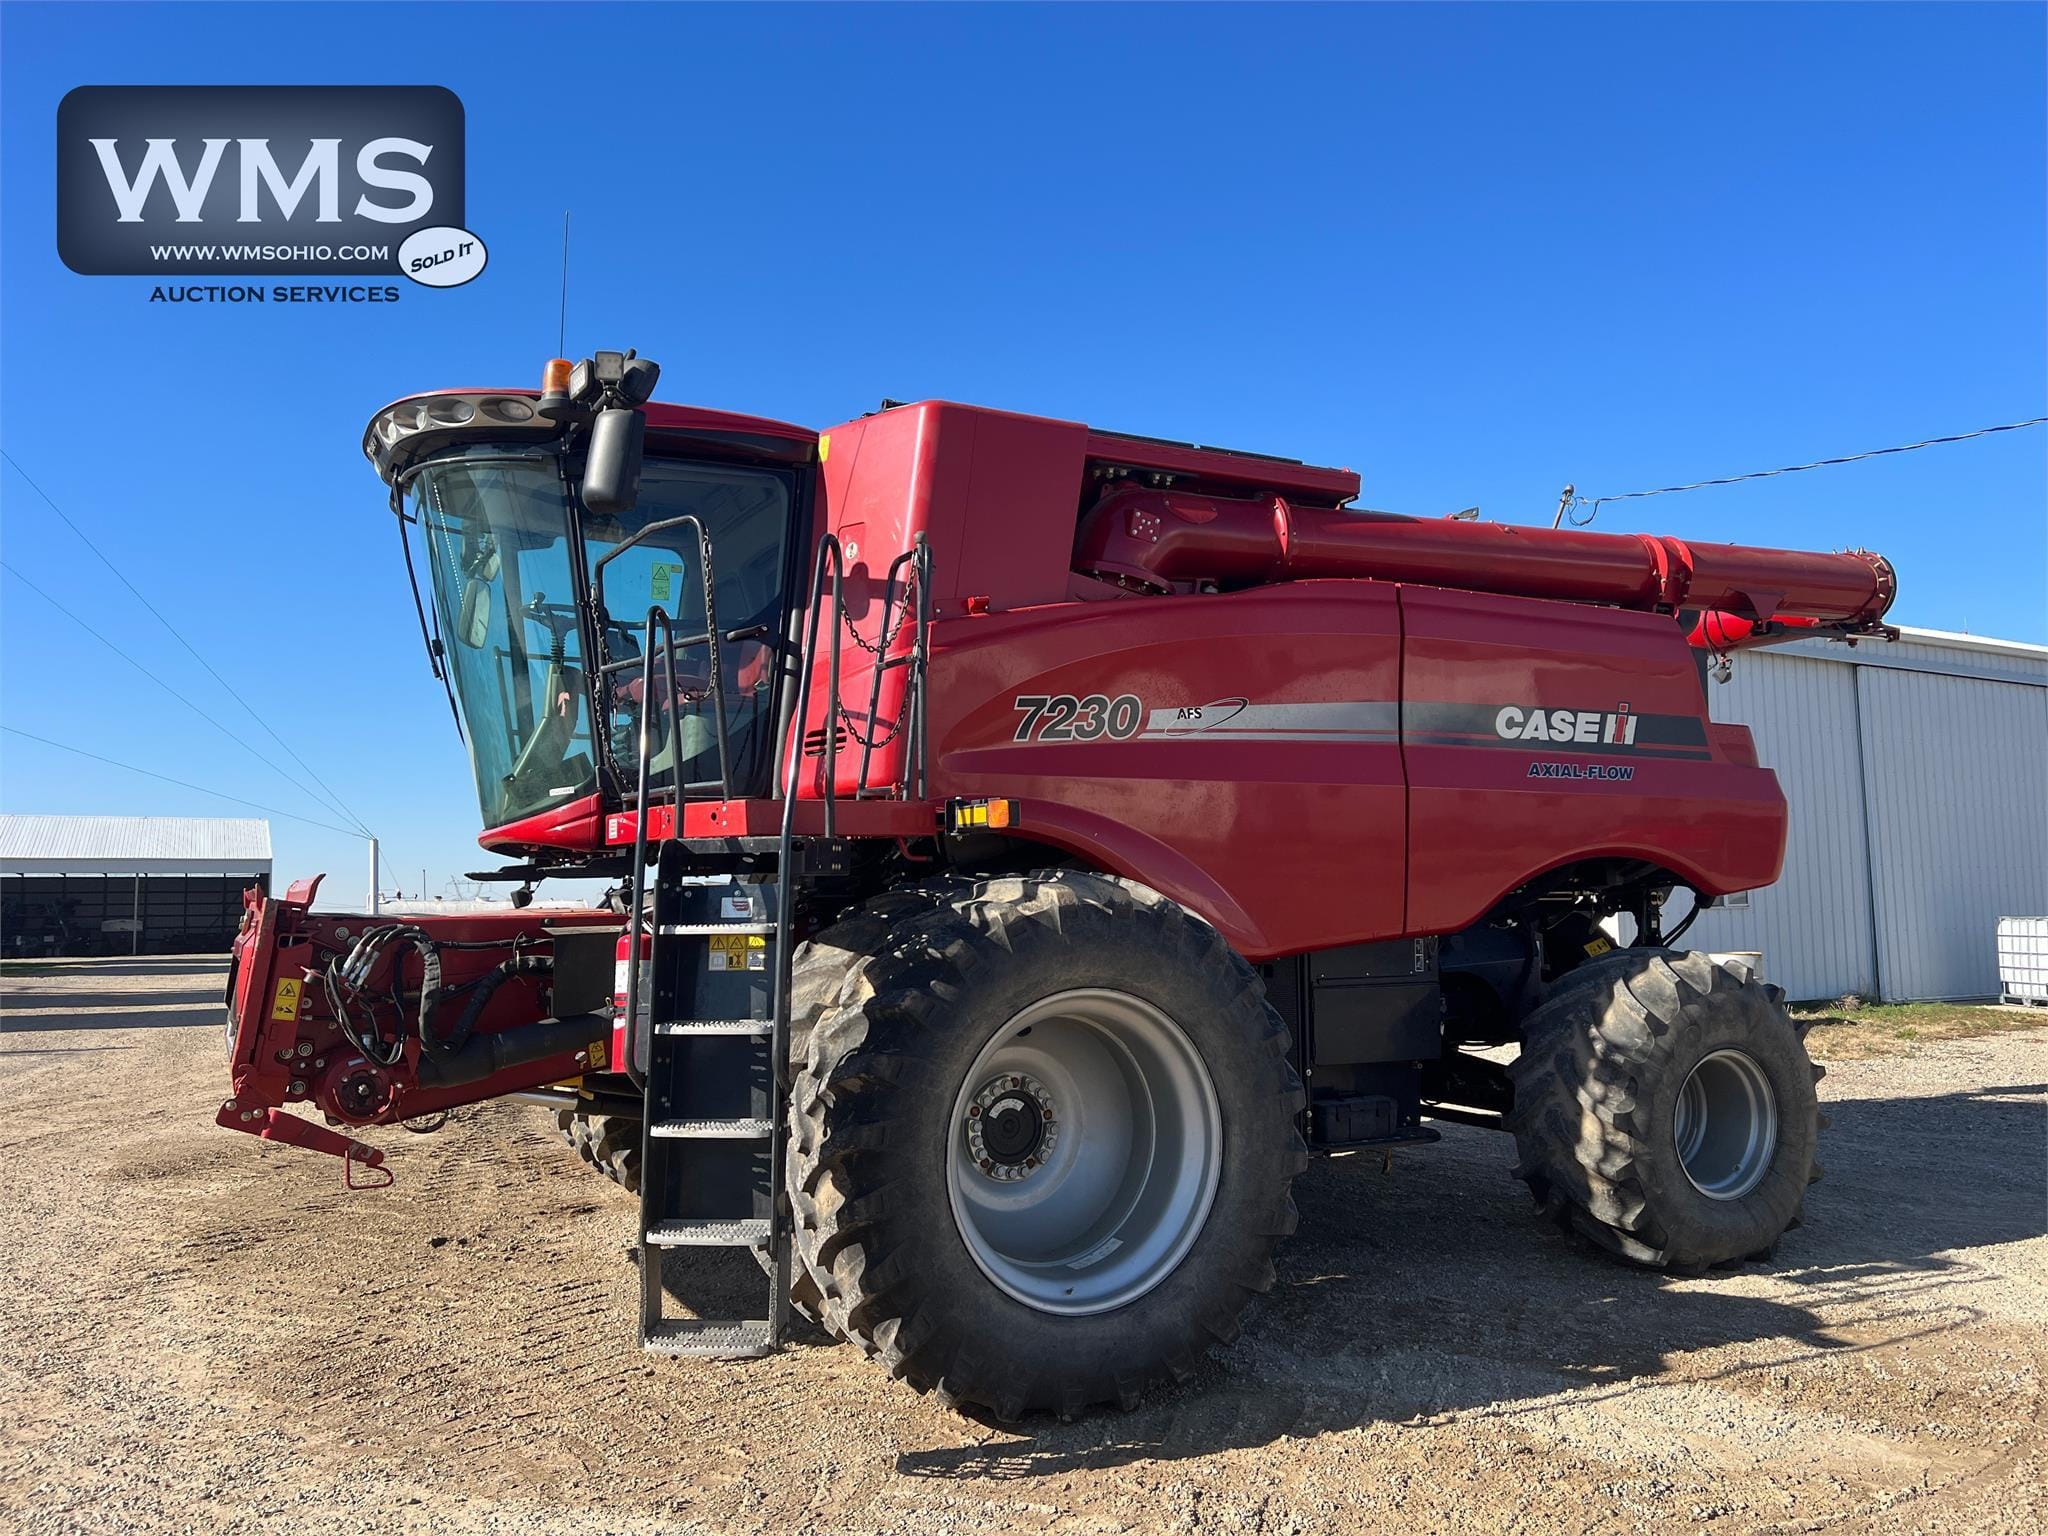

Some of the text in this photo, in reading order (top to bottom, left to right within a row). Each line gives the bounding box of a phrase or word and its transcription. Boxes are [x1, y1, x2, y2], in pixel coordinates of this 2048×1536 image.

[1013, 693, 1143, 742] 7230
[1176, 707, 1203, 720] AFS
[1495, 706, 1601, 743] CASE
[1527, 762, 1635, 781] AXIAL-FLOW
